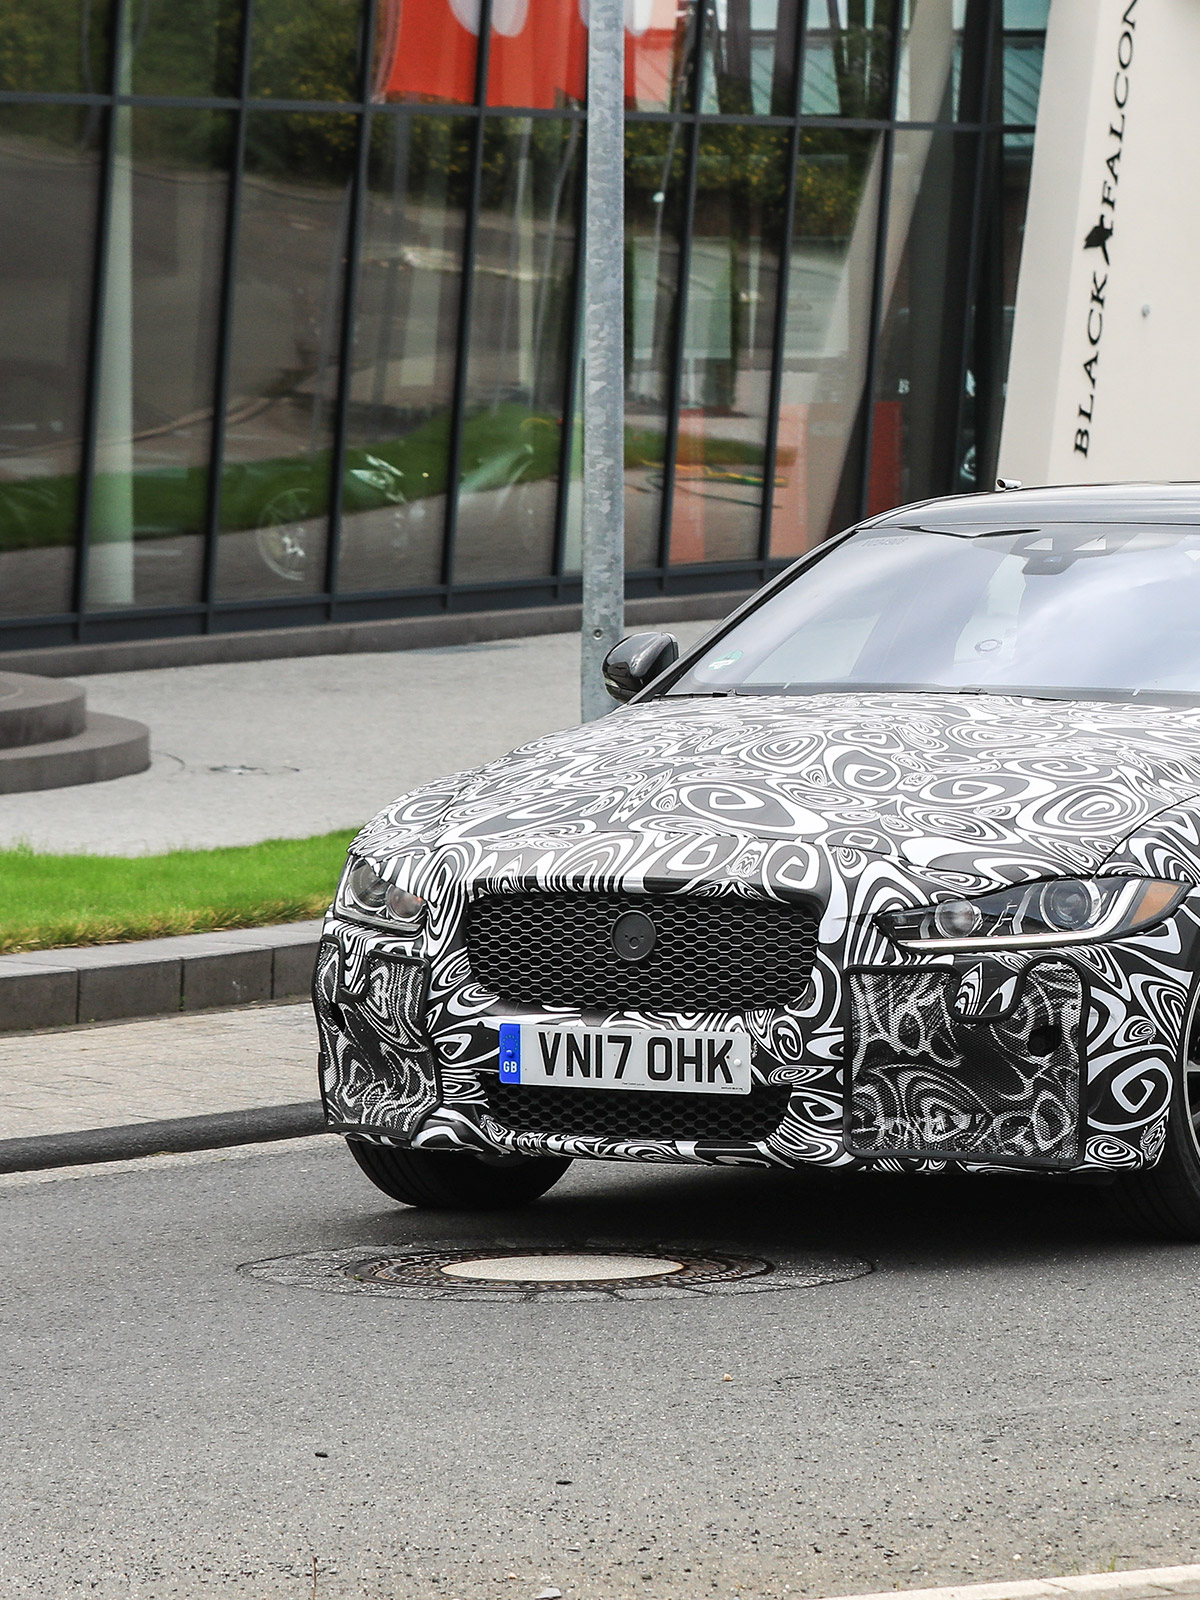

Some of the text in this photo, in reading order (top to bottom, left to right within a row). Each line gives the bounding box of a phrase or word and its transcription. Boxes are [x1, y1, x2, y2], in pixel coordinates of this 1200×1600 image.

[1074, 271, 1107, 459] BLACK
[503, 1060, 518, 1073] GB
[538, 1031, 734, 1084] VN17 OHK
